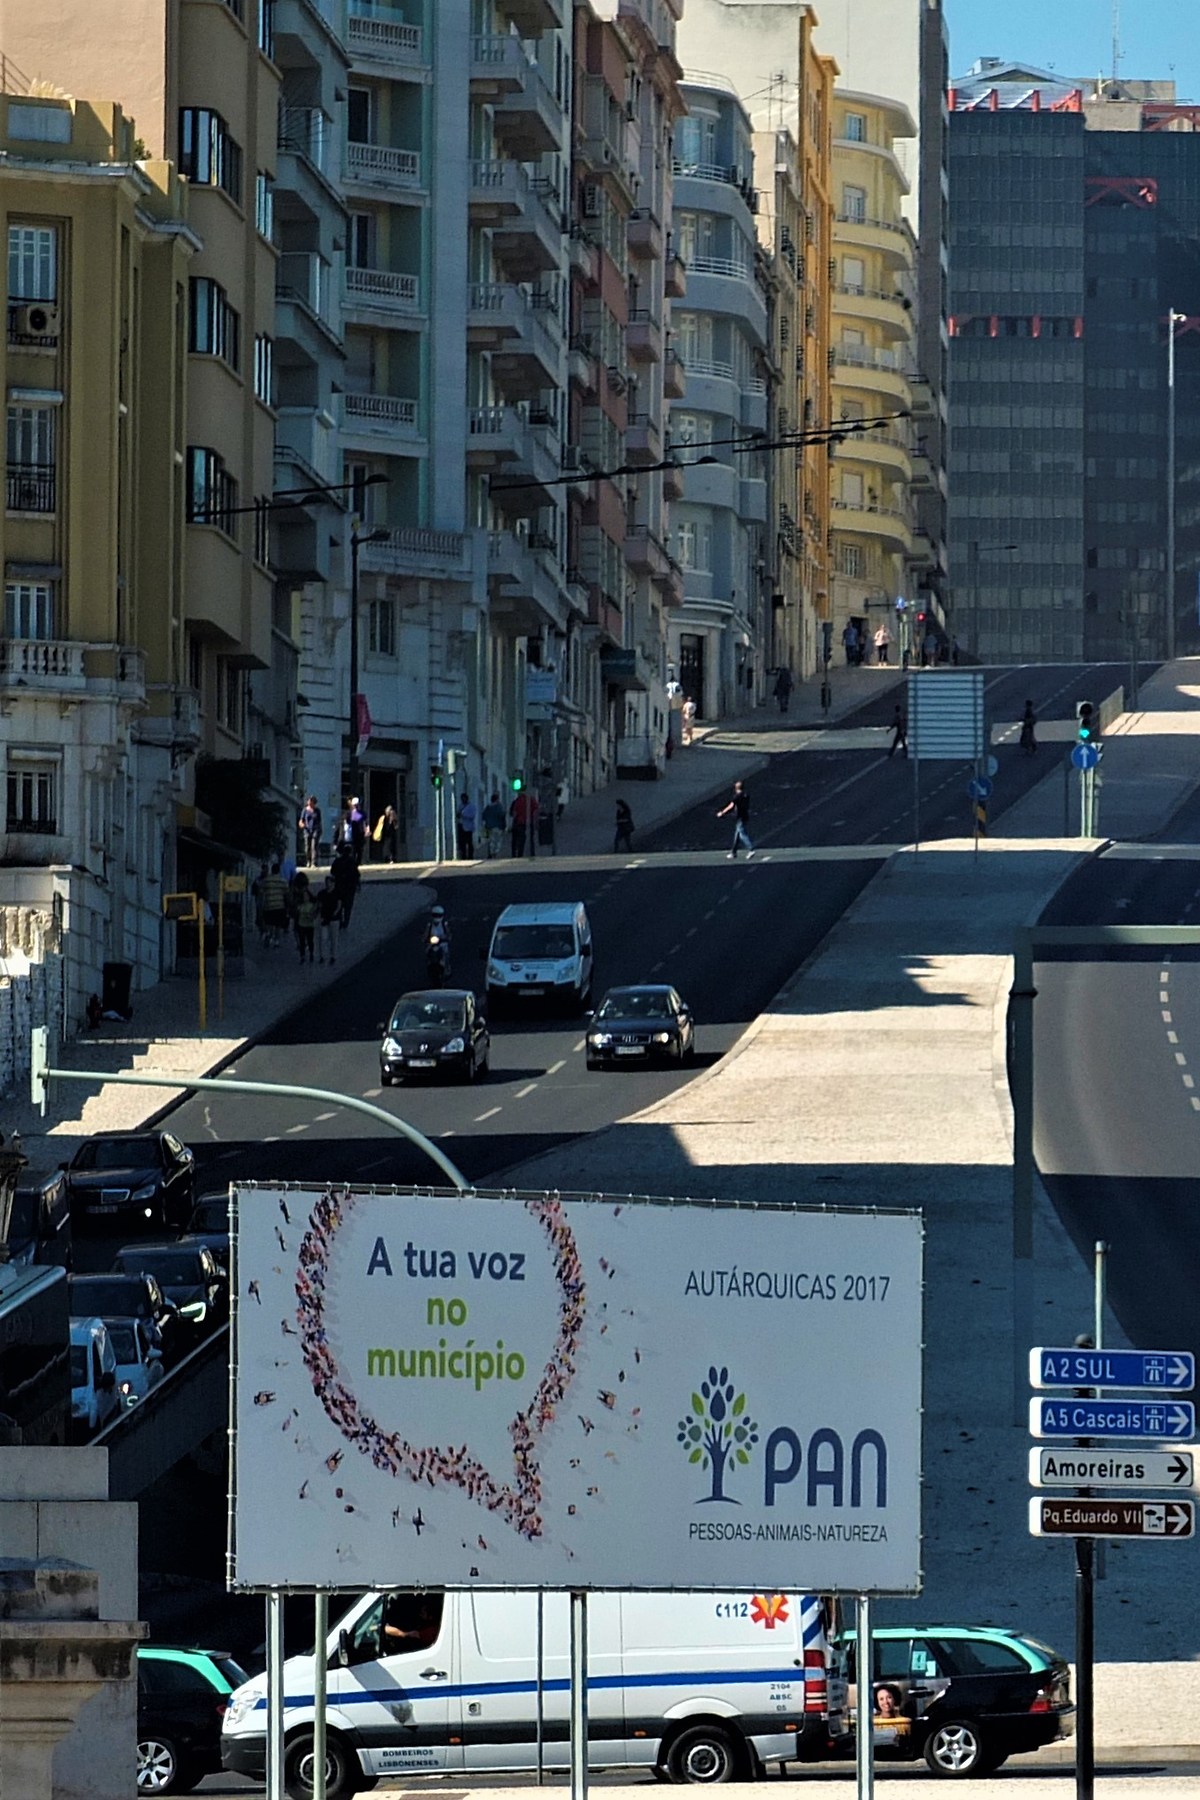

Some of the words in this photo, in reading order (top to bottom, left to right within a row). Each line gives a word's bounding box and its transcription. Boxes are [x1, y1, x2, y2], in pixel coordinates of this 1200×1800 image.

[367, 1237, 392, 1276] A
[404, 1241, 457, 1279] tua
[468, 1250, 526, 1281] voz
[684, 1266, 838, 1301] AUTÁRQUICAS
[843, 1275, 891, 1301] 2017
[427, 1297, 467, 1327] no
[367, 1340, 525, 1391] município
[1075, 1358, 1115, 1379] SUL
[1072, 1408, 1141, 1429] Cascais
[764, 1426, 888, 1508] PAN
[1044, 1458, 1144, 1478] Amoreiras
[1123, 1509, 1142, 1523] VII
[688, 1522, 888, 1543] PESSOAS-ANIMAIS-NATUREZA
[715, 1602, 748, 1618] C112
[382, 1749, 434, 1757] BOMBEIROS
[378, 1760, 439, 1768] LISBONENSES
